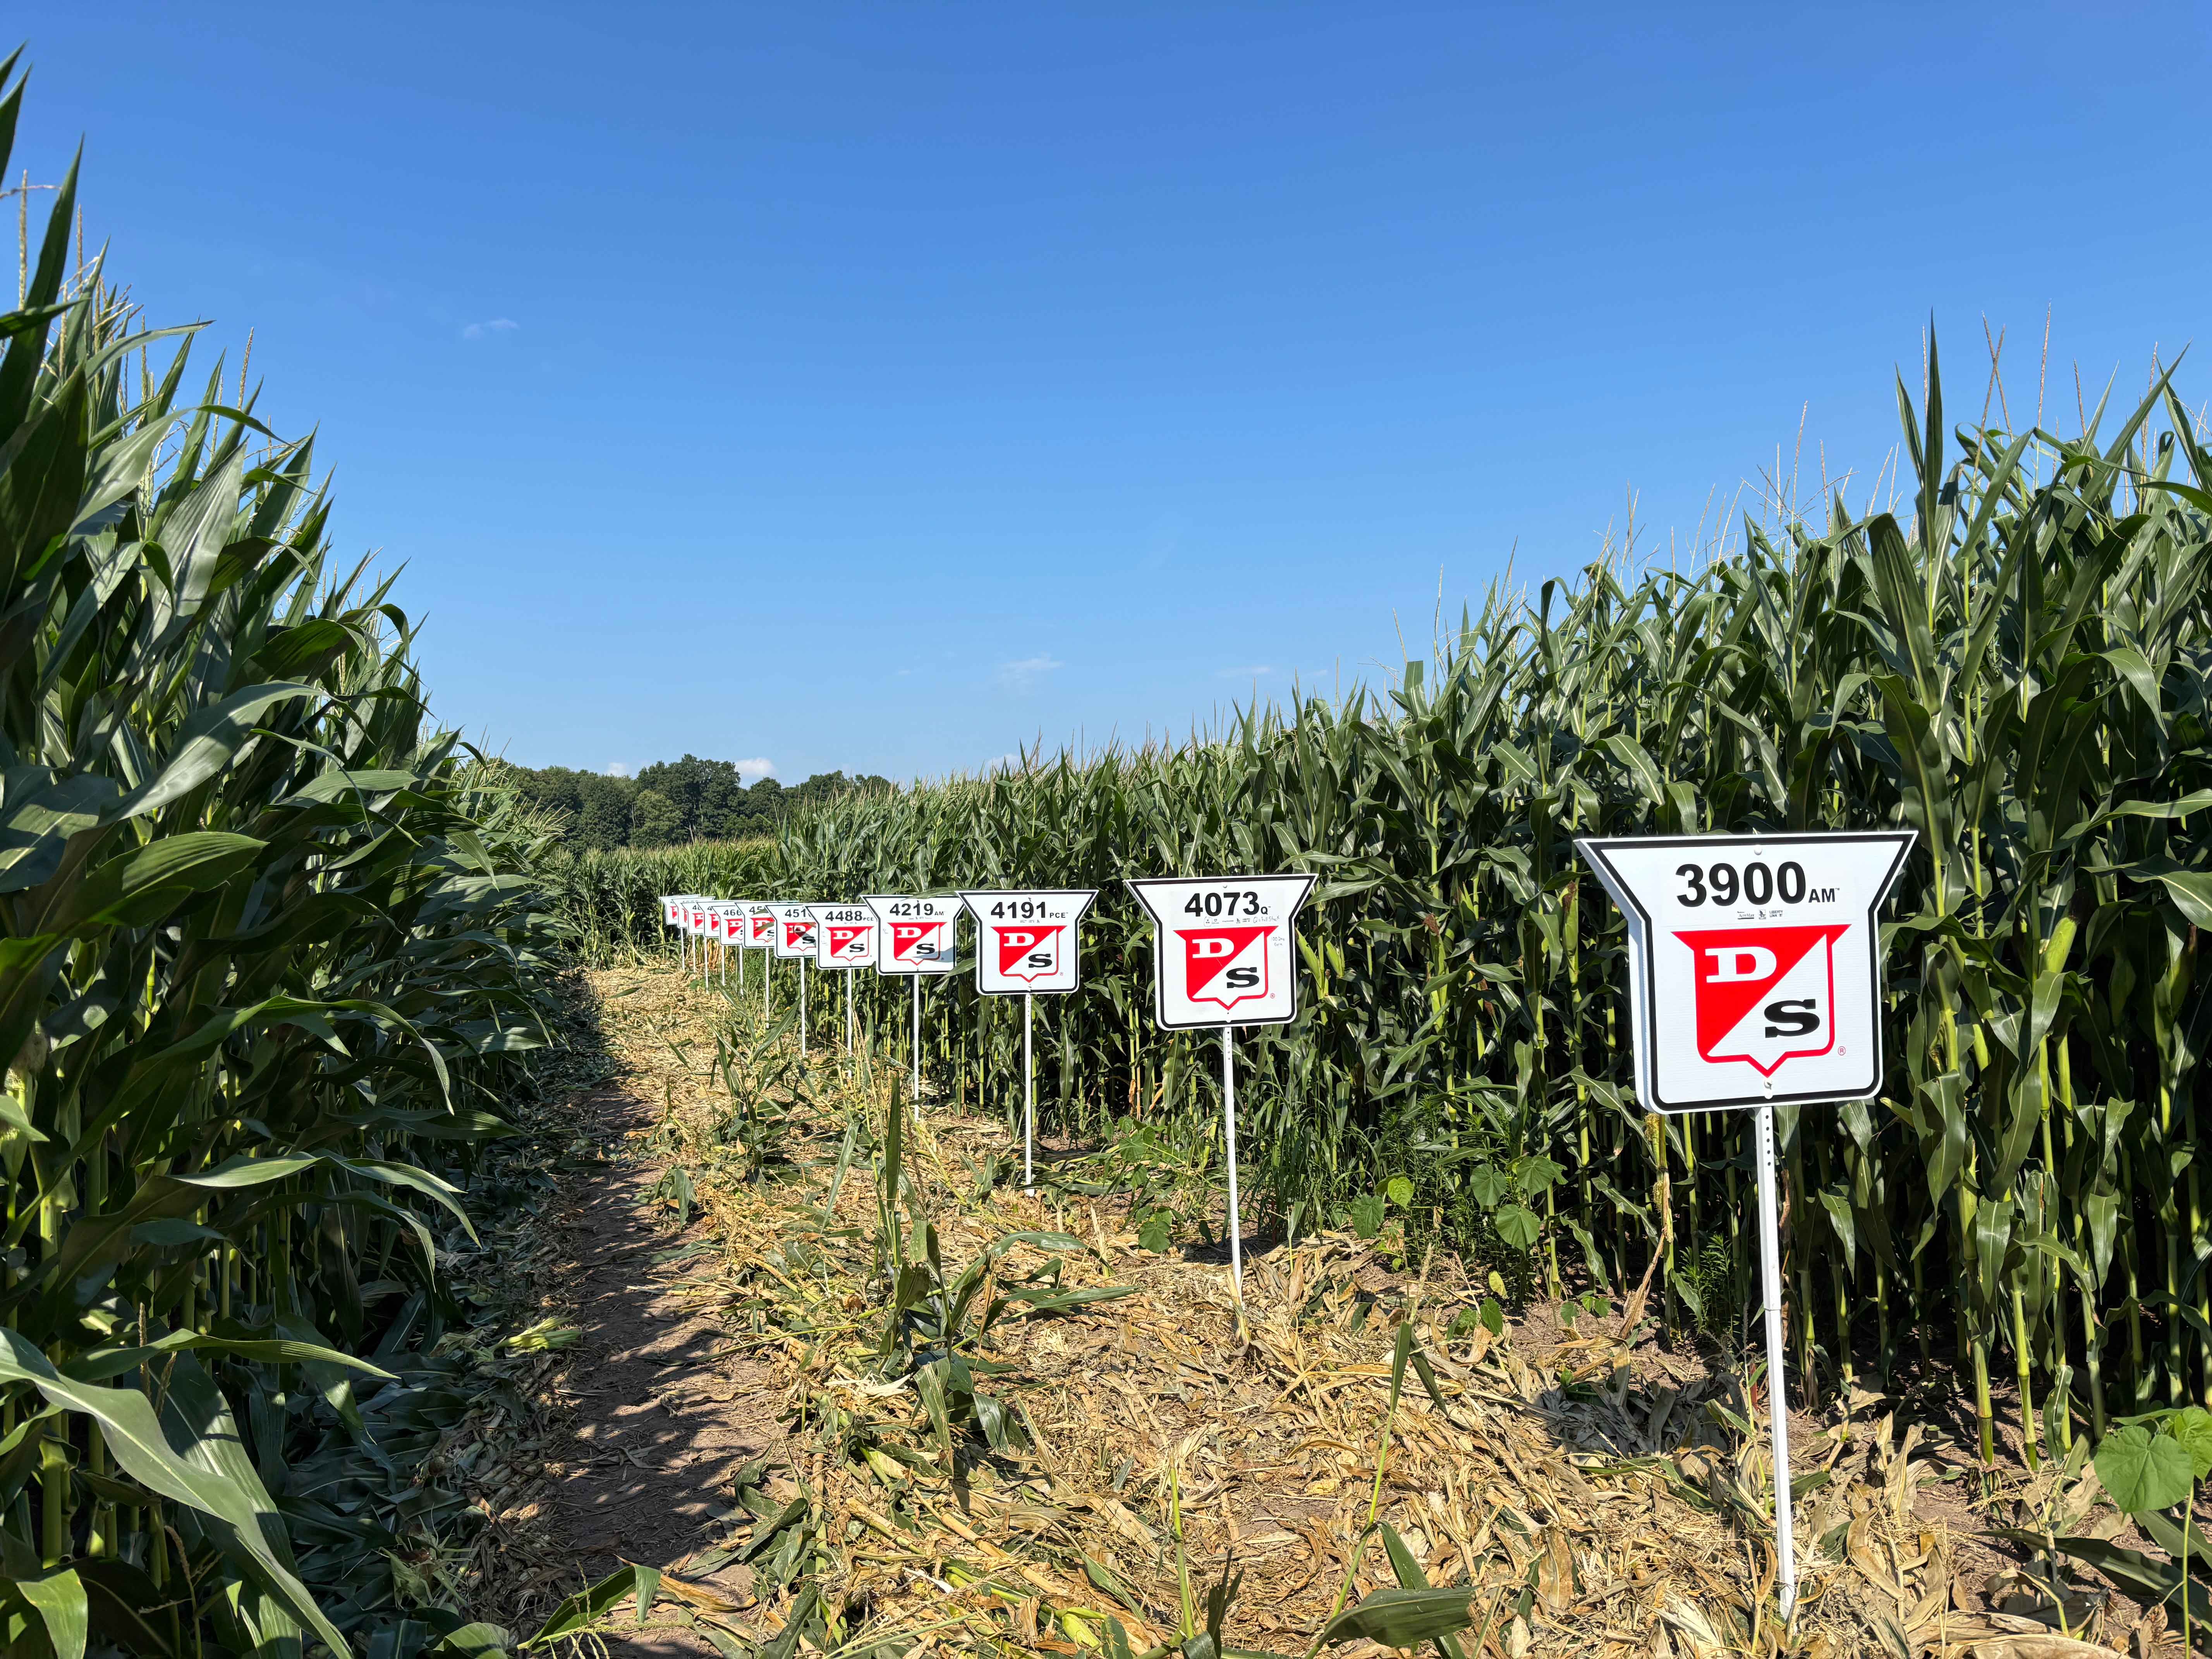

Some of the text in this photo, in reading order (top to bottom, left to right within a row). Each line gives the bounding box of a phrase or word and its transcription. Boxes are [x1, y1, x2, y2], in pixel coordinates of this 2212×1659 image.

[1676, 861, 1806, 907] 3900
[890, 903, 934, 916] 4219
[991, 902, 1046, 919] 4191
[1185, 891, 1259, 917] 4073
[785, 908, 810, 917] 451
[825, 910, 862, 922] 4488
[833, 930, 854, 939] D
[897, 927, 922, 938] D
[1004, 933, 1035, 947] D
[849, 943, 865, 953] S
[916, 943, 935, 955] S
[1192, 938, 1235, 958] D
[1028, 953, 1053, 968] S
[1705, 946, 1777, 983] D
[1226, 967, 1259, 989] S
[1764, 999, 1820, 1038] S
